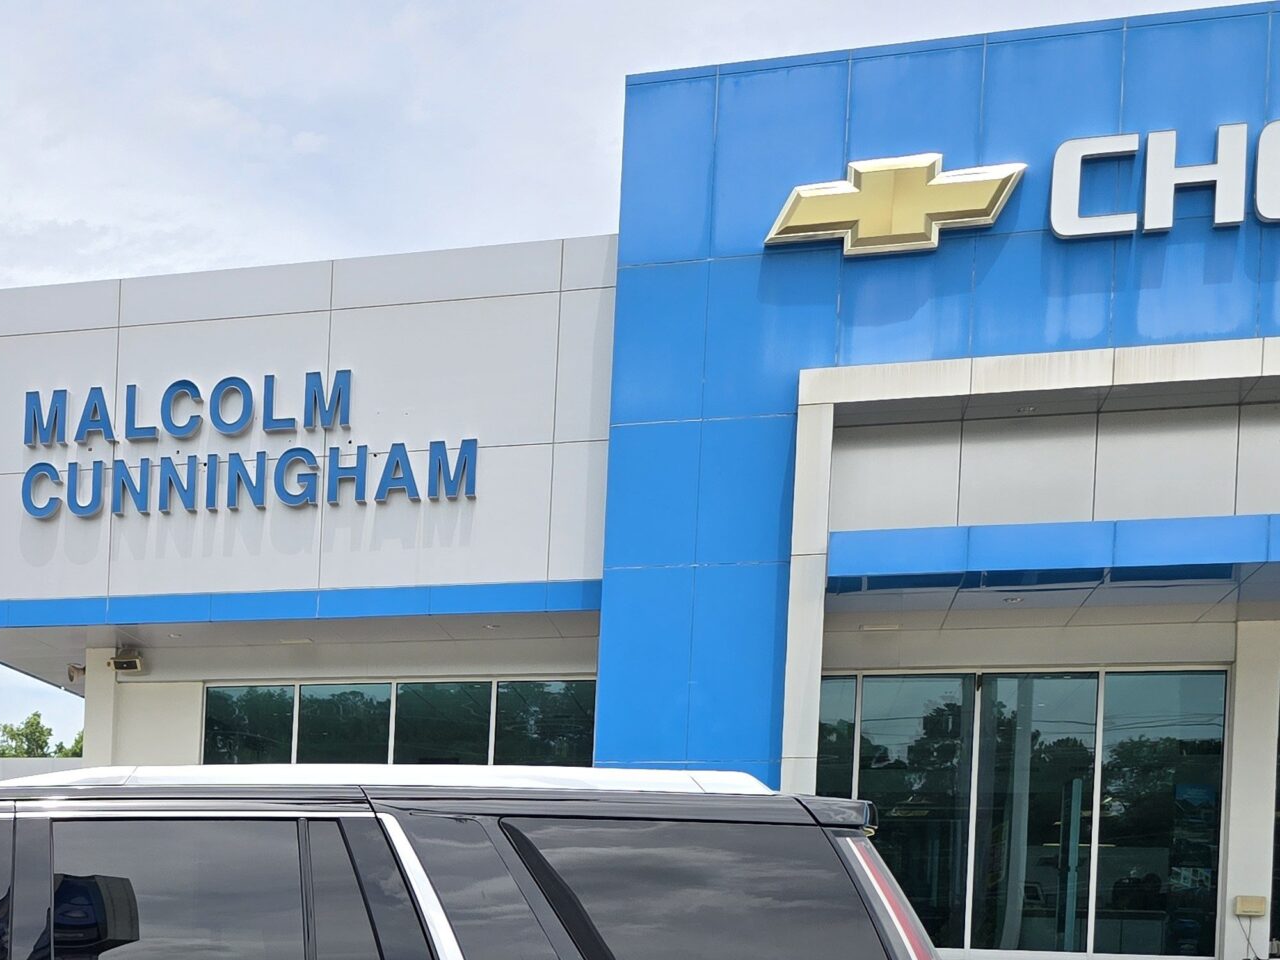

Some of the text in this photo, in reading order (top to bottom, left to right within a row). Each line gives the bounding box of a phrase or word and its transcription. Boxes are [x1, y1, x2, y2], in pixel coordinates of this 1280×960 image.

[1050, 119, 1280, 239] CH
[23, 369, 352, 448] MALCOLM
[21, 438, 478, 519] CUNNINGHAM
